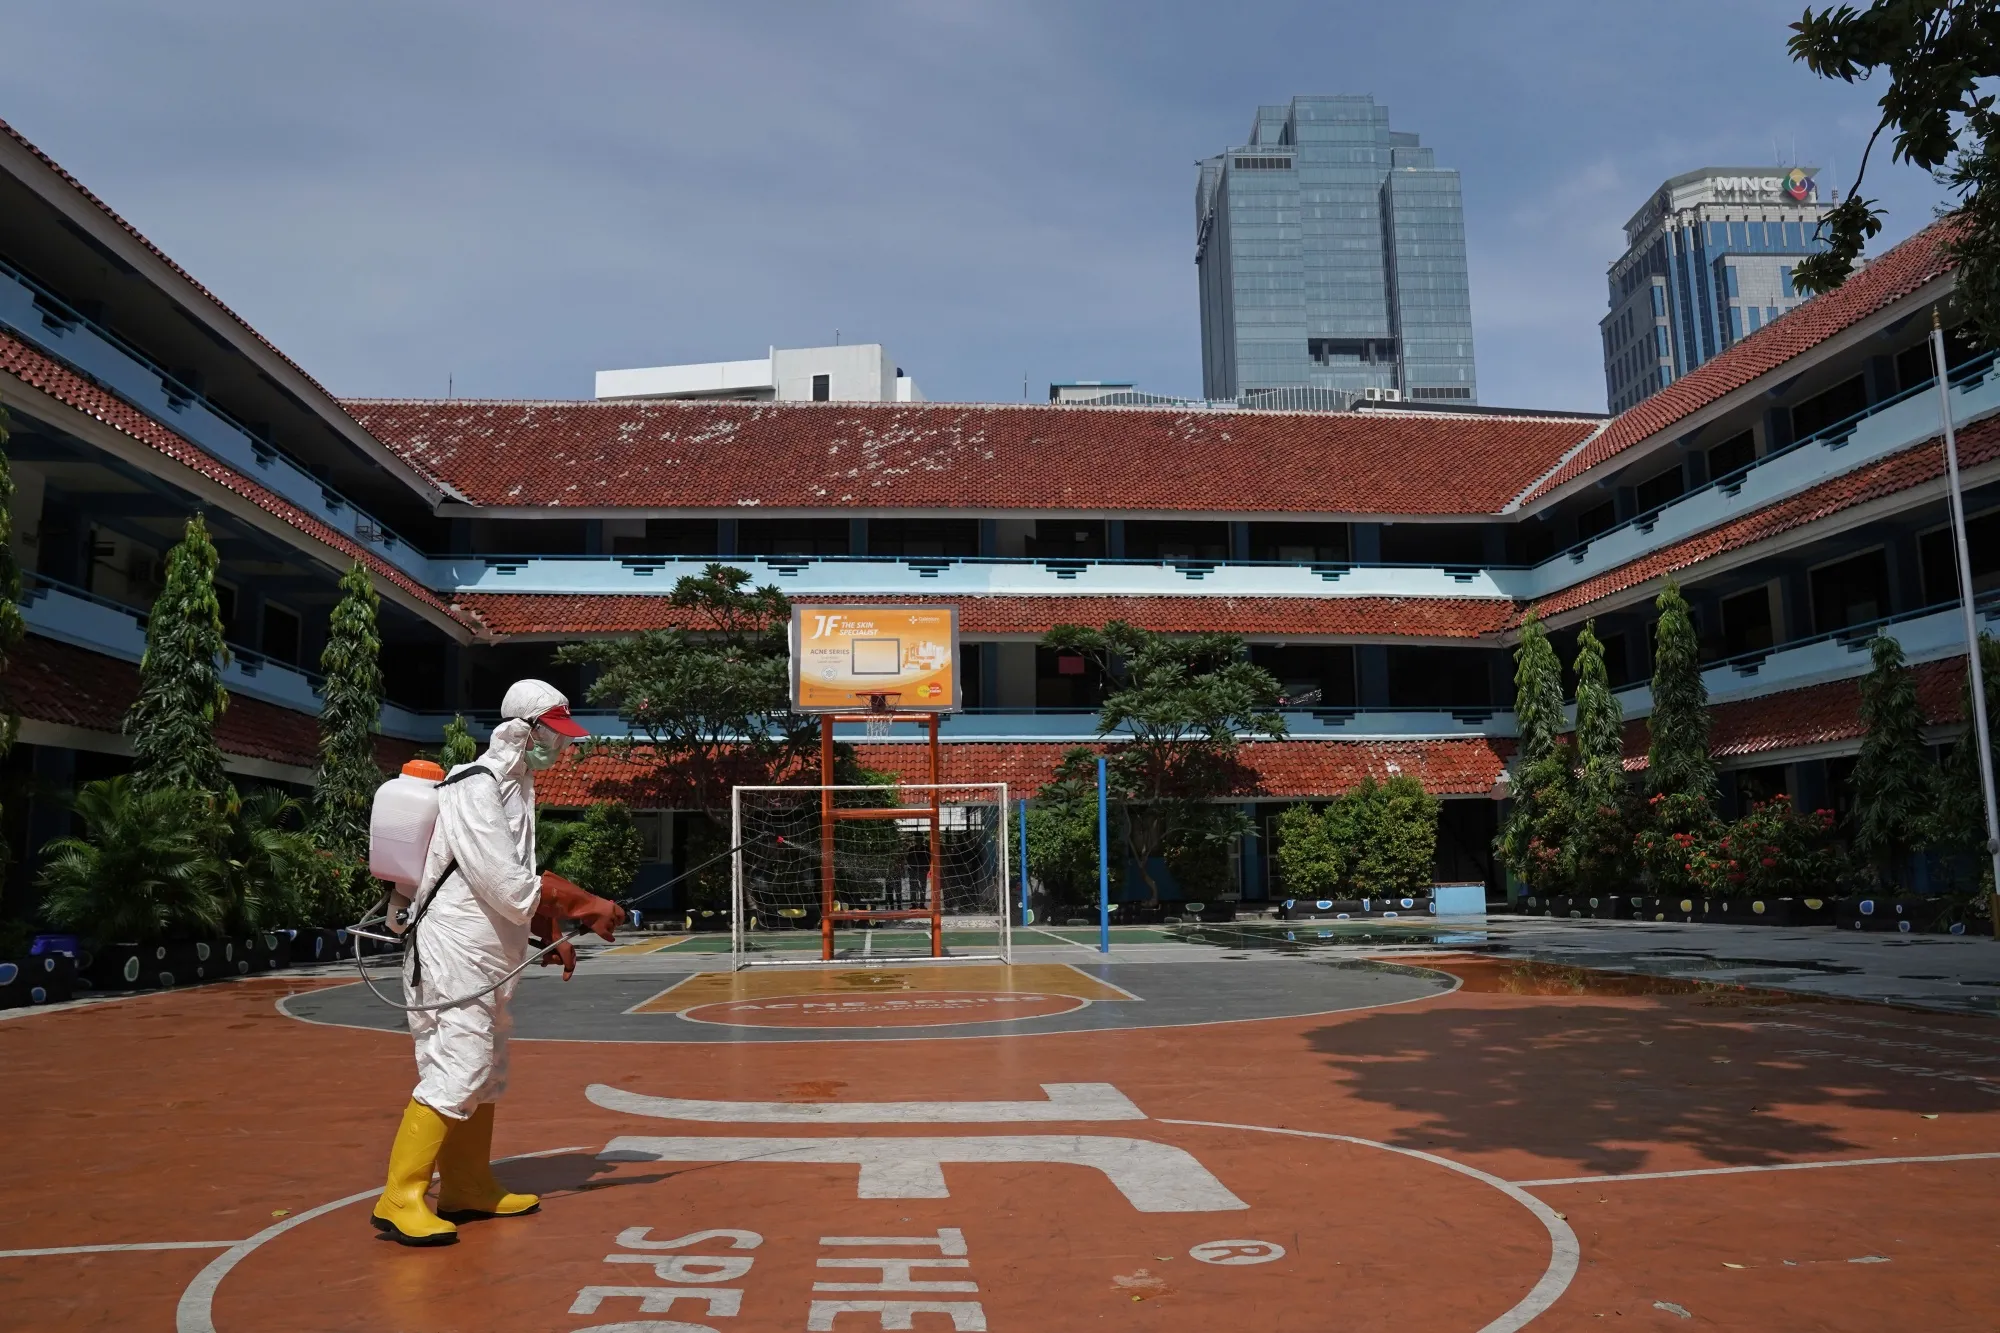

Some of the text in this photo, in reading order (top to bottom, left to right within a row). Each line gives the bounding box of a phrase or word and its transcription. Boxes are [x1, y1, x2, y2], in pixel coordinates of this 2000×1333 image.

[1716, 176, 1779, 191] MNC
[810, 615, 842, 640] JF
[841, 621, 875, 629] THE SKIN
[729, 1001, 866, 1011] ACNE
[884, 996, 1049, 1004] SERIES
[585, 1082, 1250, 1213] JF
[567, 1226, 764, 1333] SPE
[808, 1227, 987, 1333] THE
